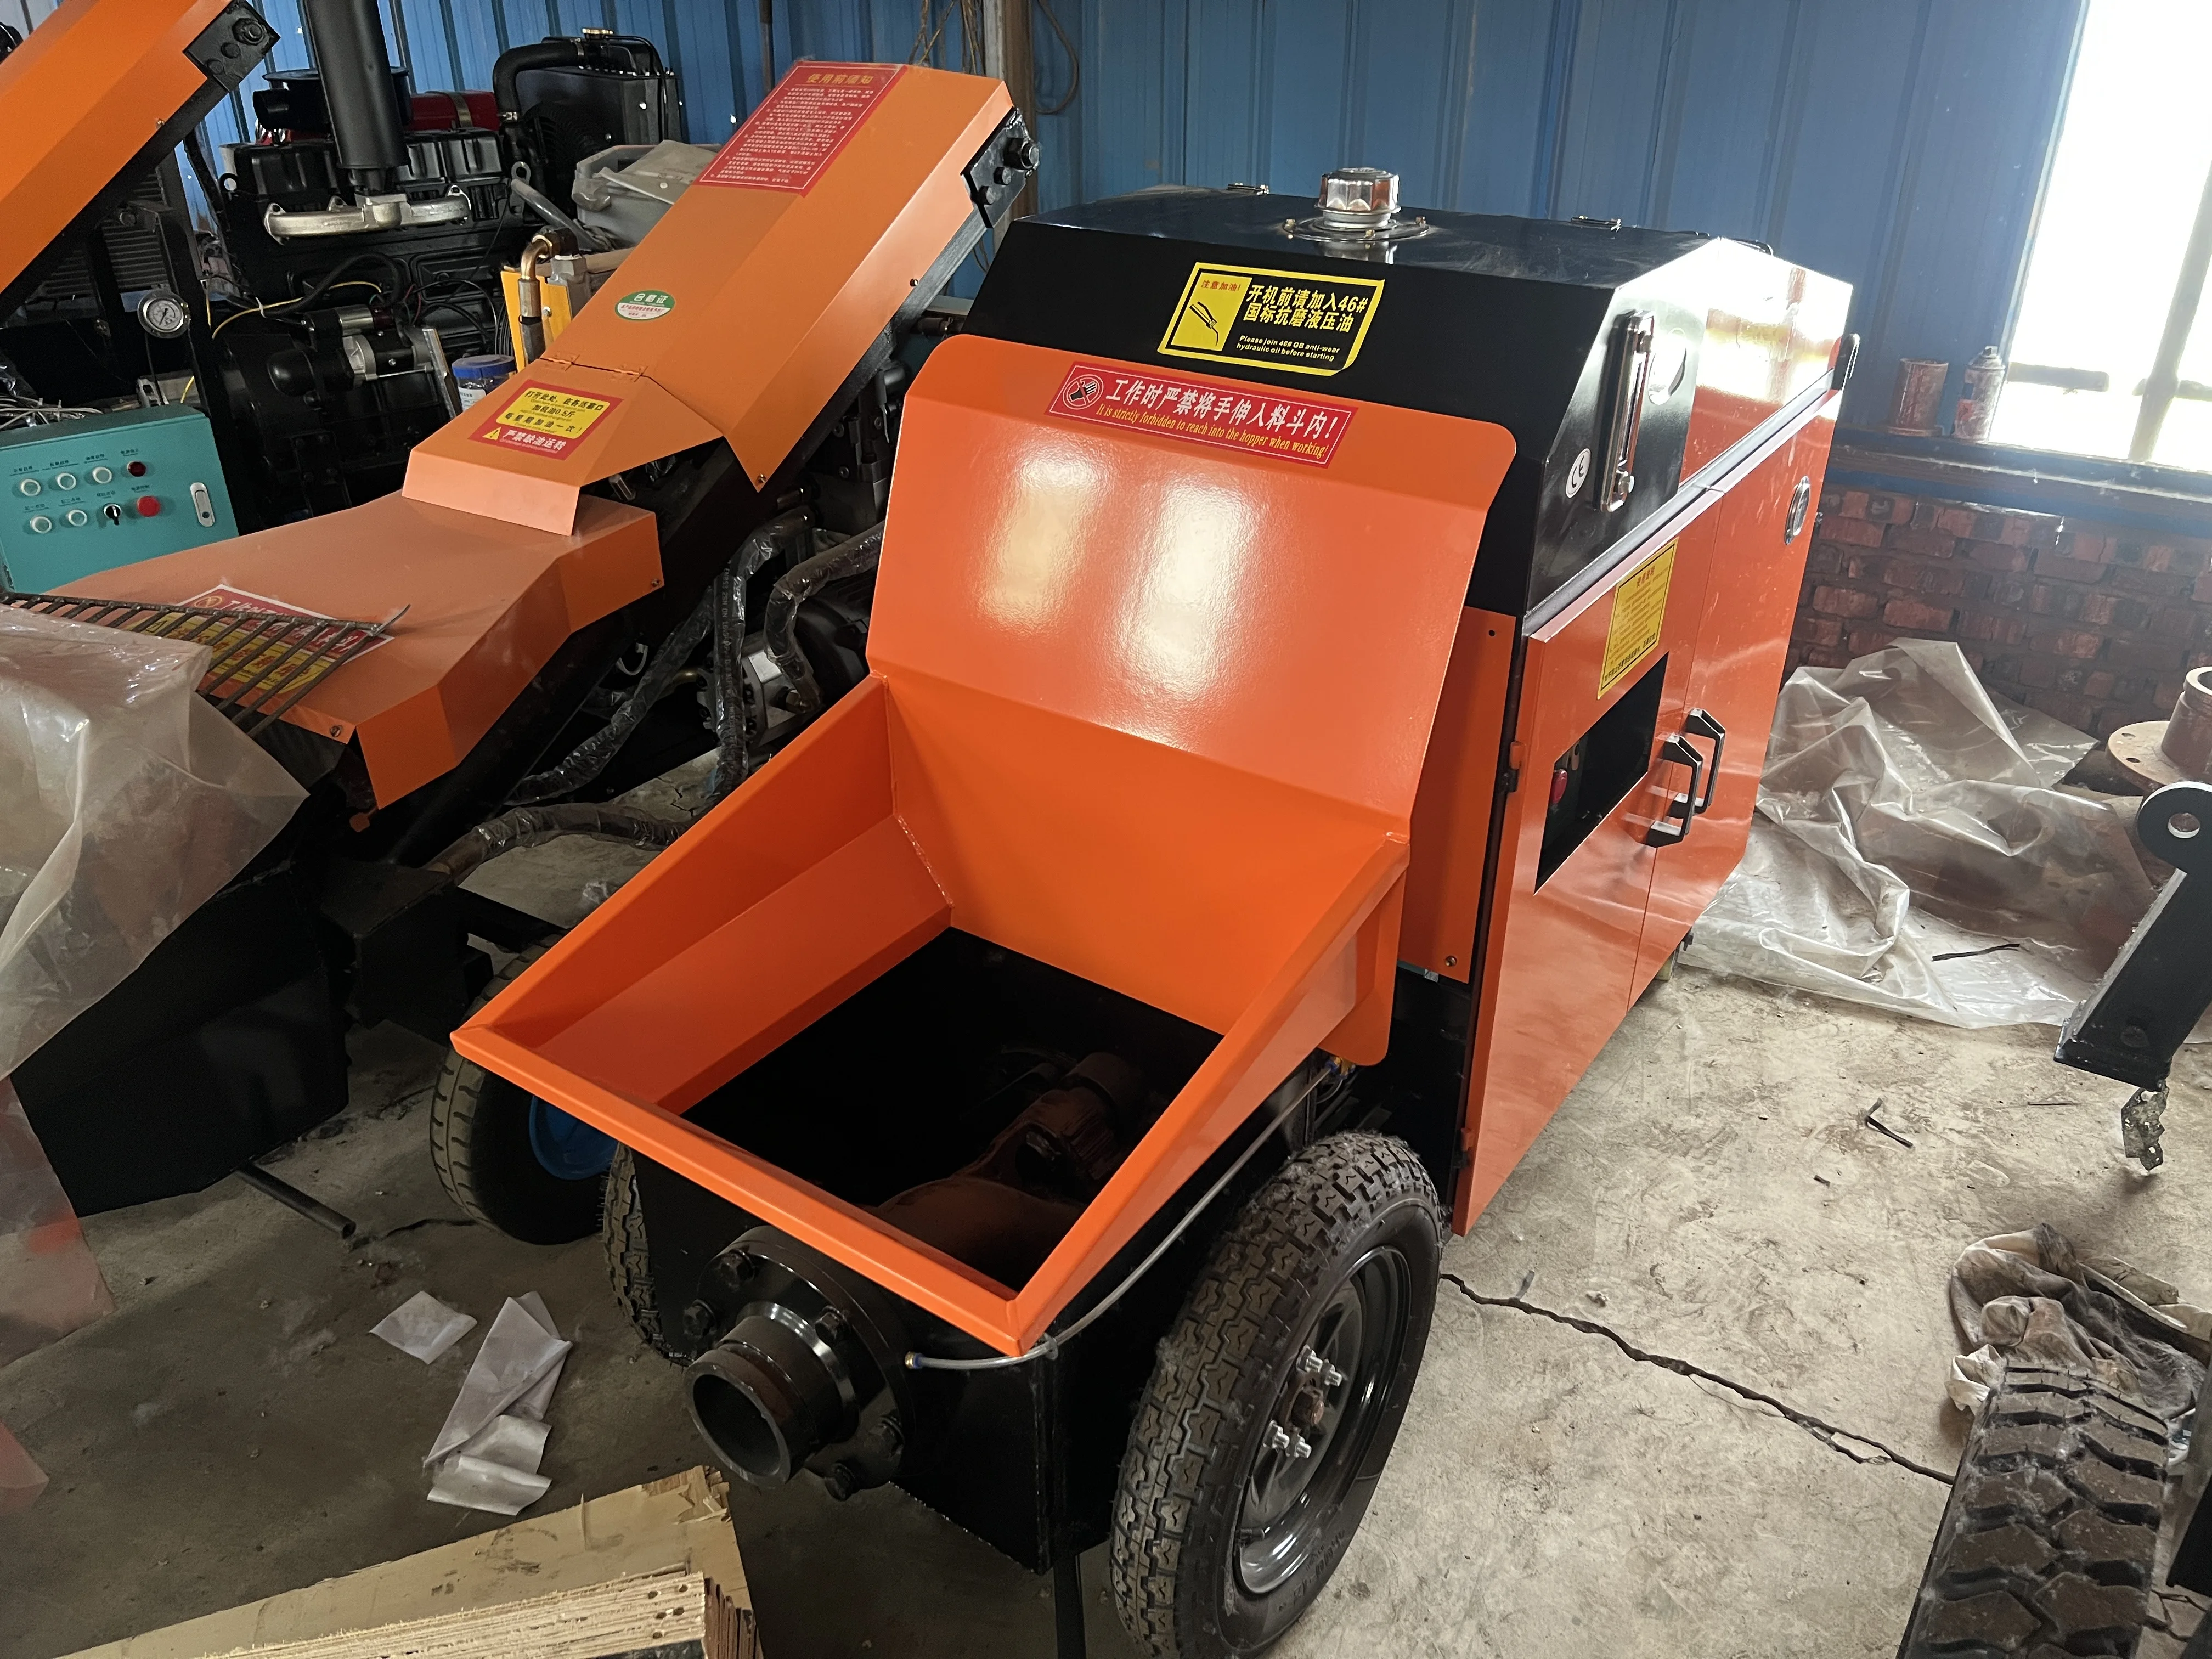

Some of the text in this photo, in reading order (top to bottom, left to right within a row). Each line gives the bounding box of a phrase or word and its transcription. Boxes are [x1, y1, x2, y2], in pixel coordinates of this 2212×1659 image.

[1246, 284, 1368, 313] 开机前请加入46#
[1243, 302, 1355, 333] 国标抗磨液压油
[1236, 342, 1269, 352] hydraulic
[1281, 348, 1304, 357] before
[1305, 352, 1335, 362] starting
[1239, 335, 1263, 344] Please
[1305, 344, 1340, 354] anti-wear
[1105, 379, 1338, 439] 工作时严禁将手伸入料斗内！
[502, 430, 567, 451] 严禁缺油运转
[1096, 403, 1329, 459] It is strictly forbidden to reach into the hopper when working!
